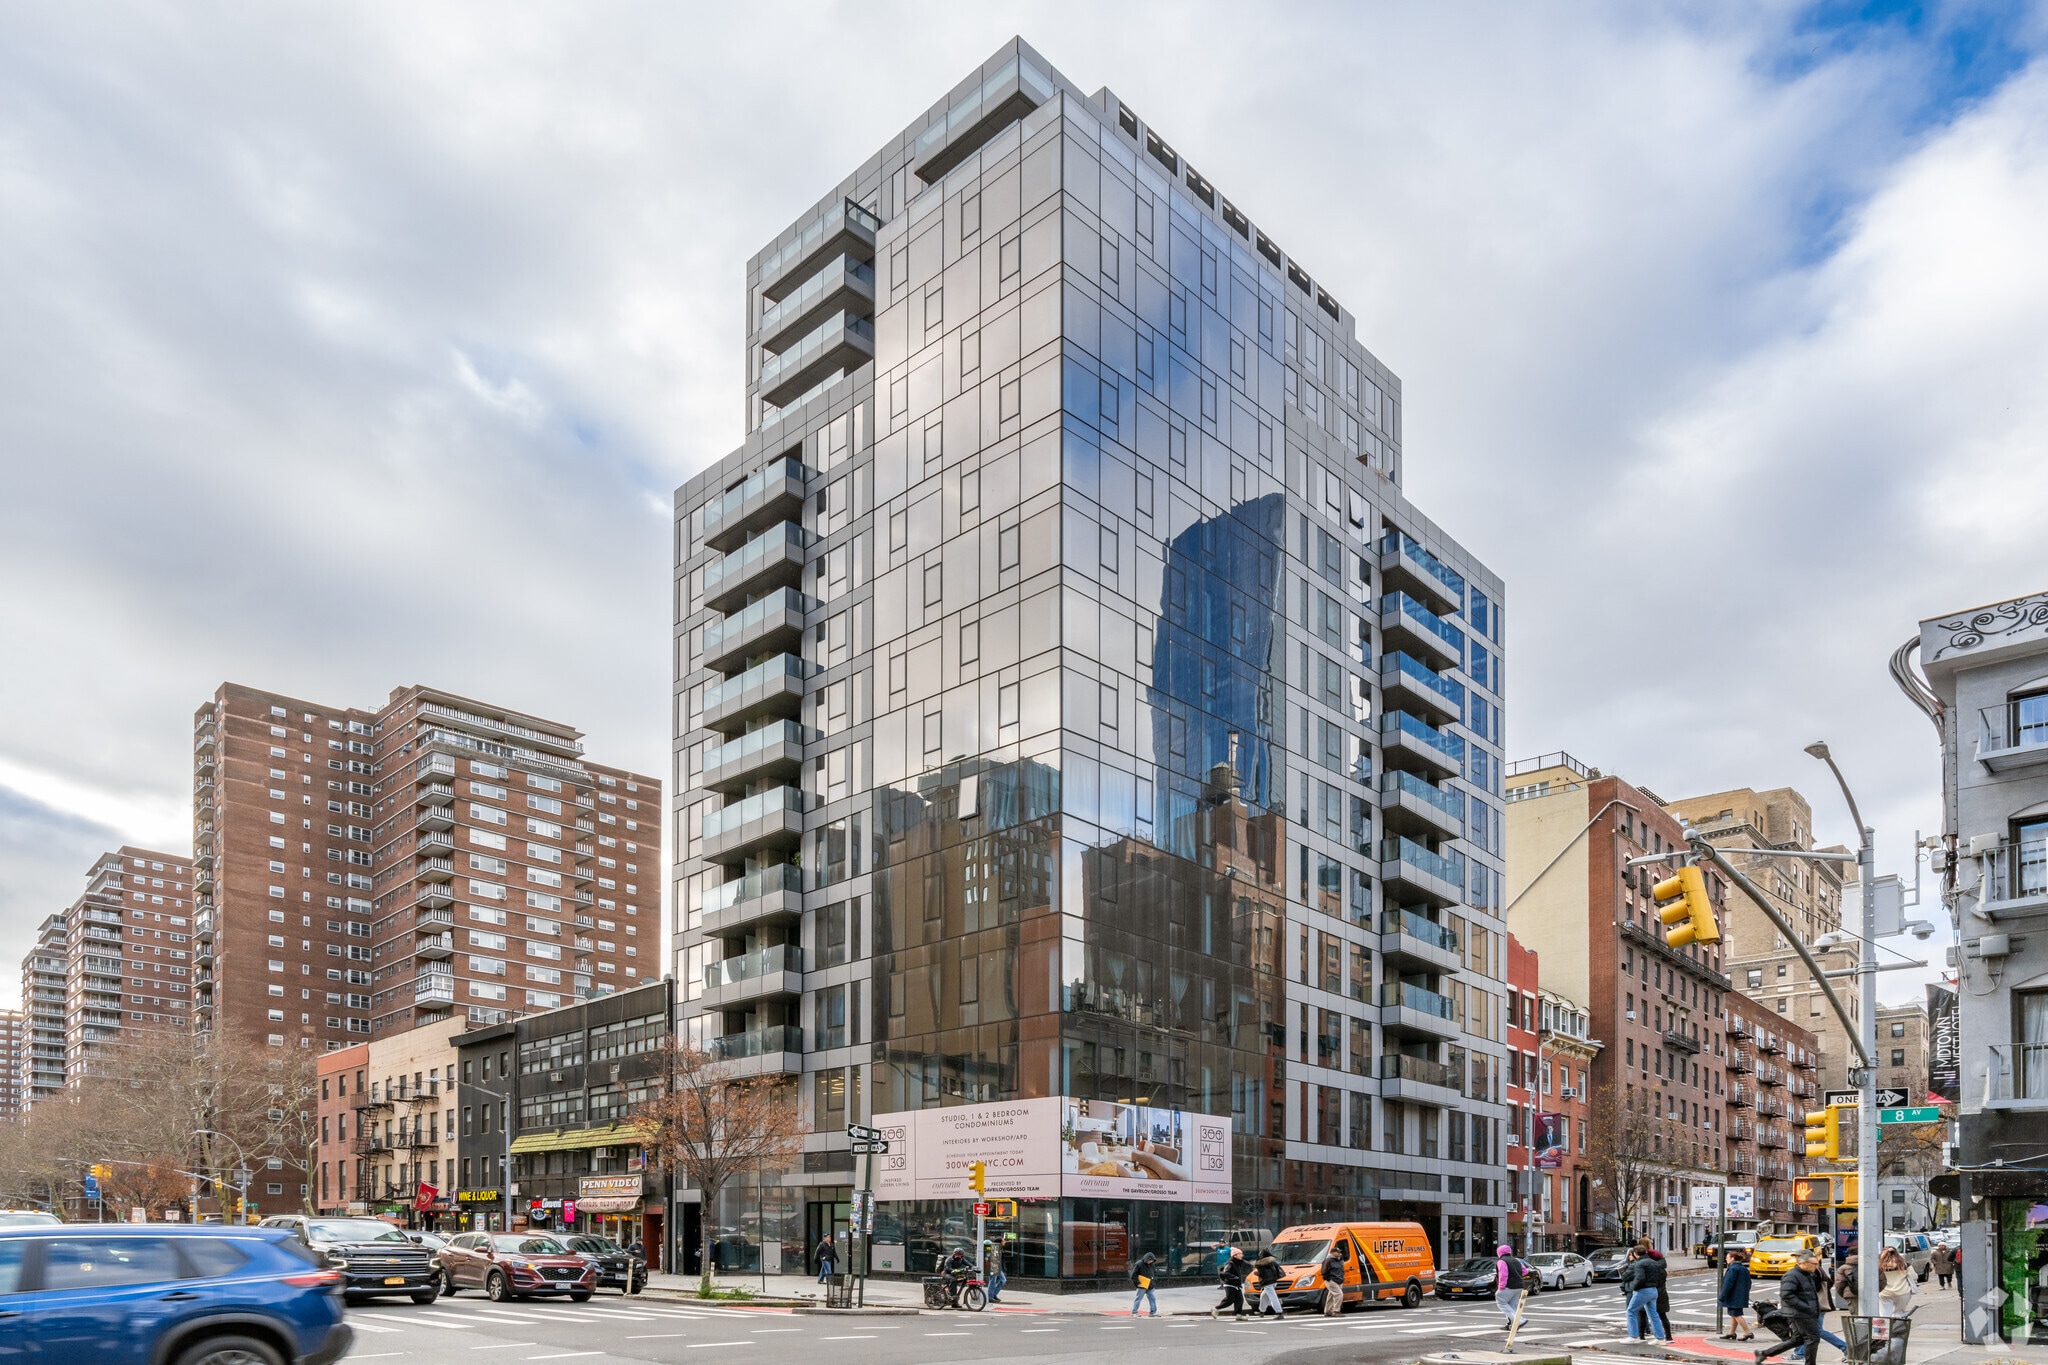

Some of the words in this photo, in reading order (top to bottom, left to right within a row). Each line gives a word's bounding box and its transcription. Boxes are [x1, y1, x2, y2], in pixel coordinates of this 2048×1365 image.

[1936, 1016, 1951, 1068] MIDTOWN
[1836, 1095, 1858, 1104] ONE
[941, 1114, 968, 1122] STUDIO,
[992, 1109, 1029, 1118] BEDROOM
[1895, 1110, 1905, 1122] 8
[954, 1119, 1014, 1129] CONDOMINIUMS
[1202, 1128, 1223, 1140] 300
[1202, 1143, 1211, 1153] W
[582, 1180, 607, 1189] PENN
[608, 1178, 639, 1188] VIDEO
[1080, 1179, 1110, 1187] corcoran
[458, 1191, 472, 1201] WINE
[471, 1191, 477, 1201] &
[476, 1190, 497, 1201] LIQUOR
[1373, 1240, 1405, 1253] LIFFEY
